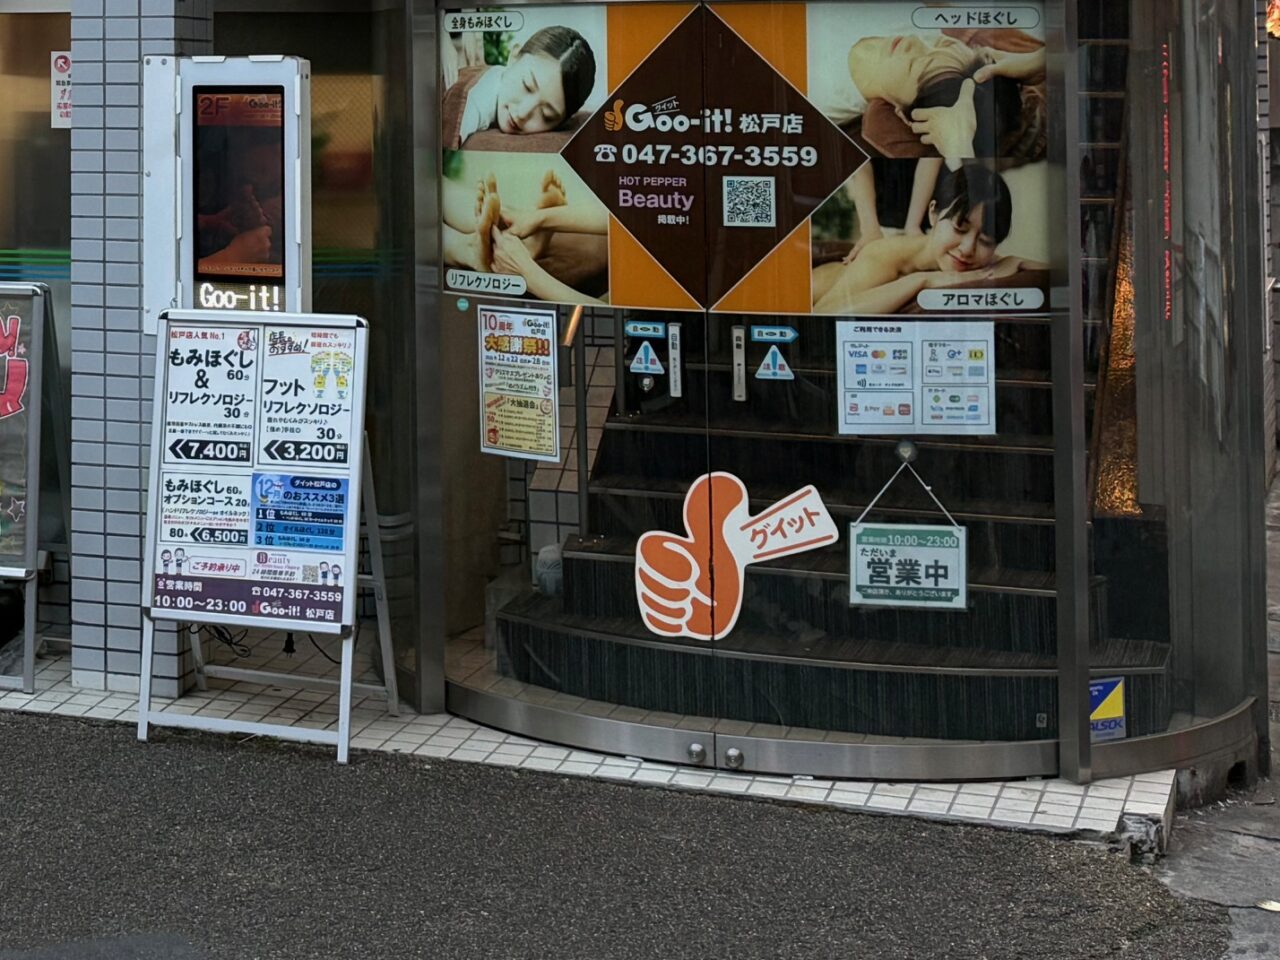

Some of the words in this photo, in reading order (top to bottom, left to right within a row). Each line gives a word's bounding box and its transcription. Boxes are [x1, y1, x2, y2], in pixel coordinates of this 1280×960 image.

[451, 16, 513, 30] 全身もみほぐし
[934, 10, 1019, 26] ヘッドほぐし
[199, 96, 230, 116] 2F
[624, 103, 733, 134] Goo-it!
[738, 113, 804, 134] 松戸店
[622, 143, 818, 167] 047-367-3559
[619, 176, 641, 186] HOT
[644, 176, 687, 188] PEPPER
[619, 189, 695, 212] Beauty
[657, 214, 690, 225] 掲載中!
[449, 272, 521, 290] リフレクソロジー
[199, 283, 280, 311] Goo-it!
[941, 291, 1024, 307] アロマほぐし
[169, 348, 254, 369] もみほぐし
[848, 350, 869, 358] VISA
[194, 369, 209, 389] &
[263, 378, 306, 397] フット
[169, 390, 254, 407] リフレクソロジー
[263, 400, 351, 416] リフレクソロジー
[188, 442, 247, 459] 7,400円
[283, 443, 345, 461] 3,200円
[165, 478, 225, 494] もみほぐし
[164, 494, 234, 507] オプションコース
[283, 491, 345, 504] のおススメ3選
[201, 529, 246, 543] 6,500円
[749, 507, 821, 550] グイット
[860, 547, 897, 558] ただいま
[866, 557, 949, 587] 営業中
[165, 580, 203, 592] 営業時間
[263, 587, 342, 603] 047-367-3559
[259, 601, 301, 617] Goo-it!
[305, 607, 335, 621] 松戸店
